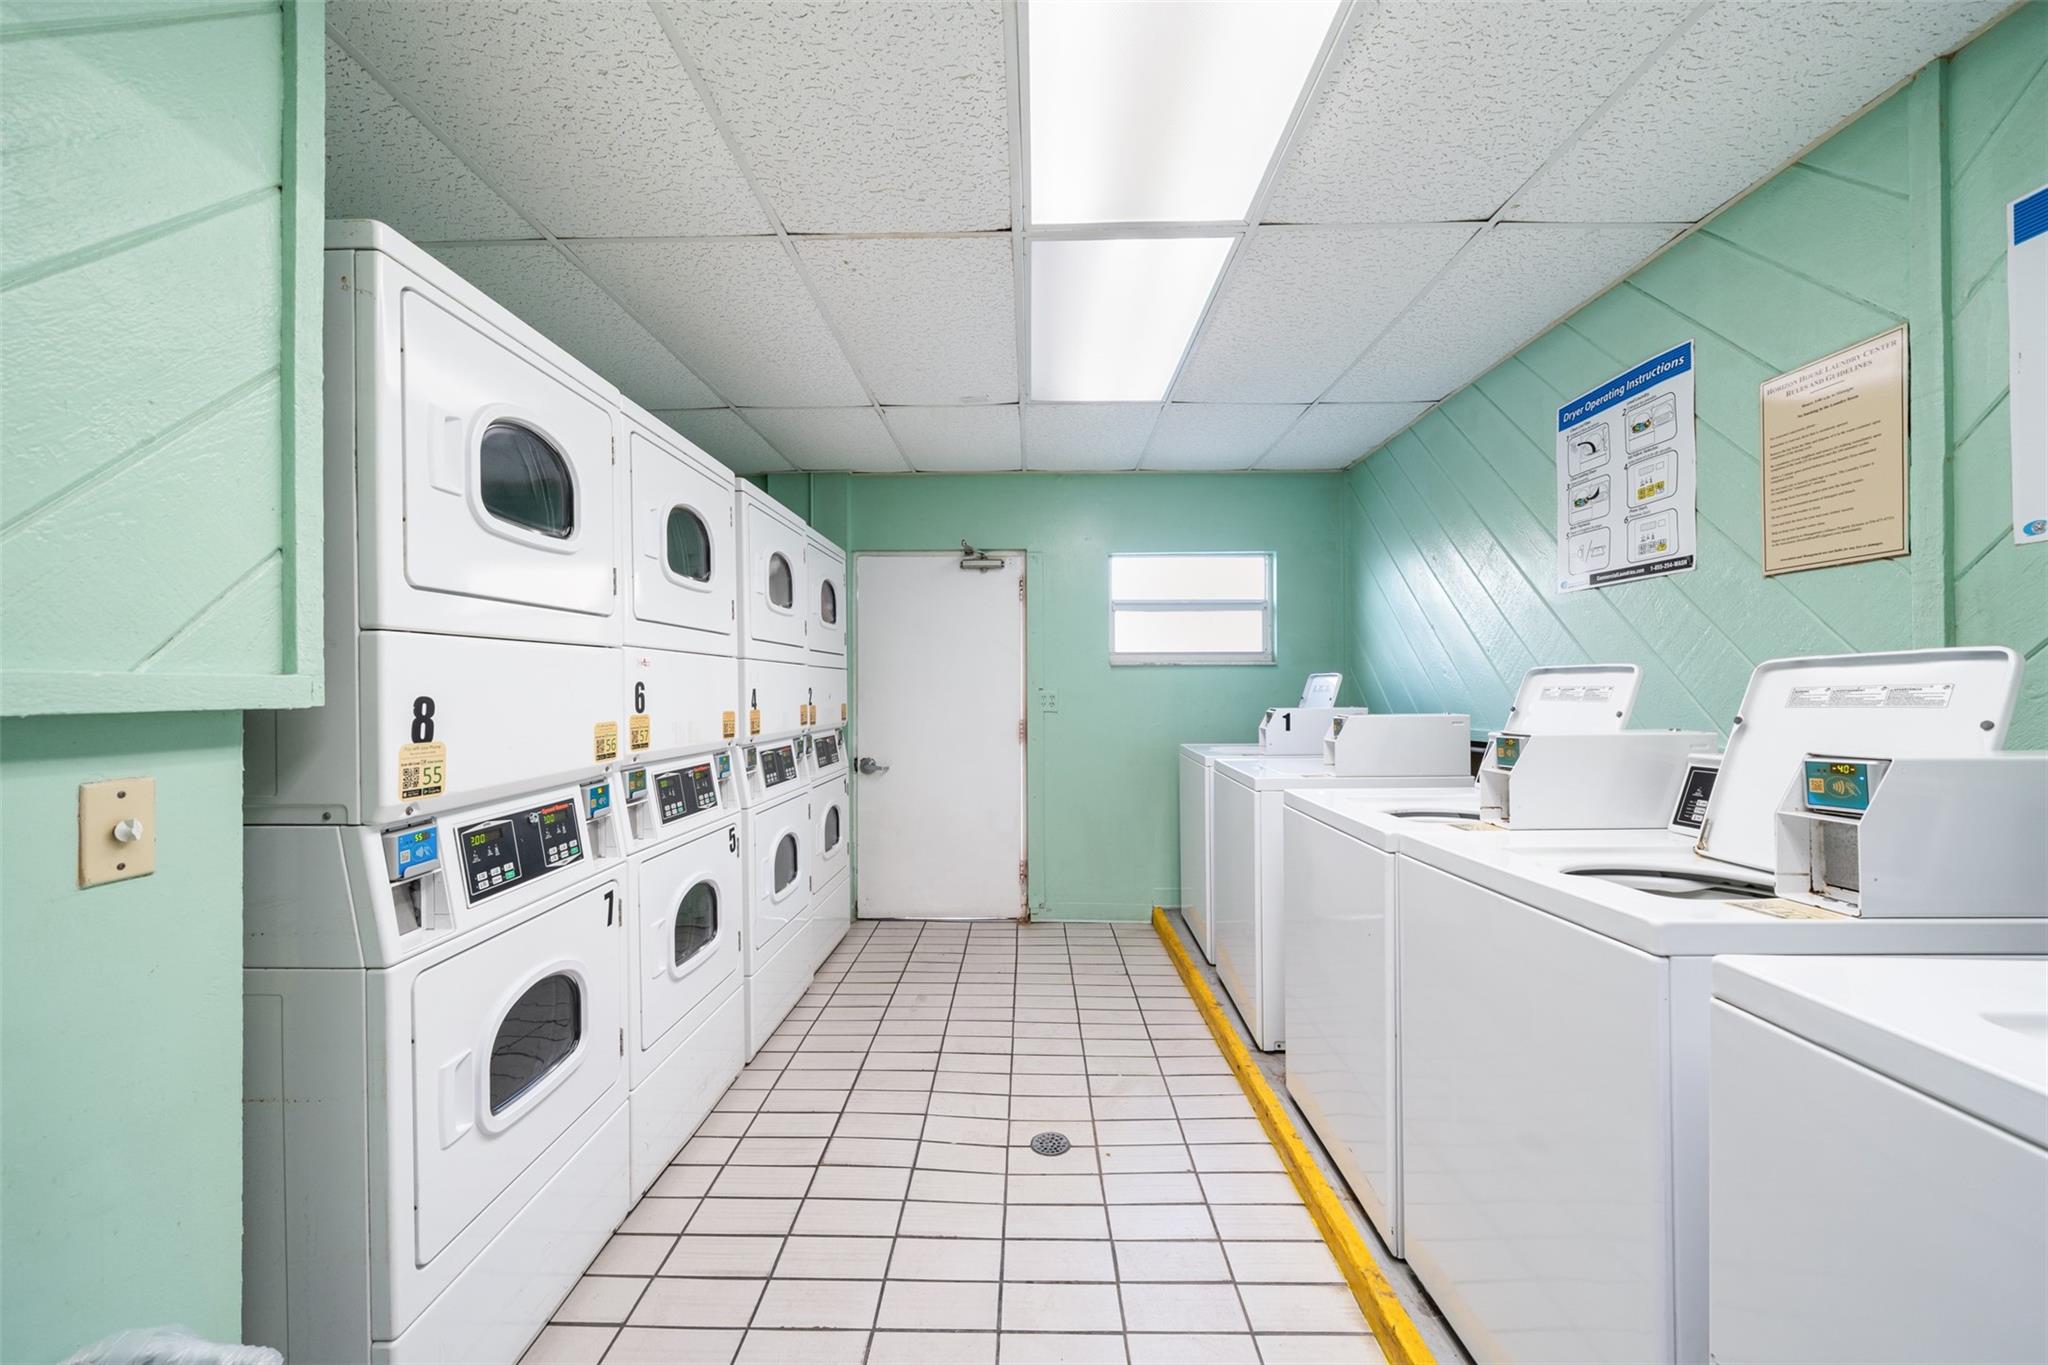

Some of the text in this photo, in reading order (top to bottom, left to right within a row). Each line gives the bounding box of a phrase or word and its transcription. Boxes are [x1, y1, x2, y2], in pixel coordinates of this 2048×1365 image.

[1863, 340, 1897, 357] CENTER
[1563, 406, 1584, 423] Dryer
[1584, 385, 1625, 411] Operating
[1626, 356, 1685, 391] Instructions
[635, 681, 645, 713] 6
[752, 688, 757, 710] 4
[808, 688, 812, 706] 2
[411, 696, 435, 743] 8
[1283, 713, 1290, 731] 1
[606, 737, 616, 752] 56
[640, 730, 648, 742] 57
[423, 766, 442, 785] 55
[729, 827, 736, 853] 5
